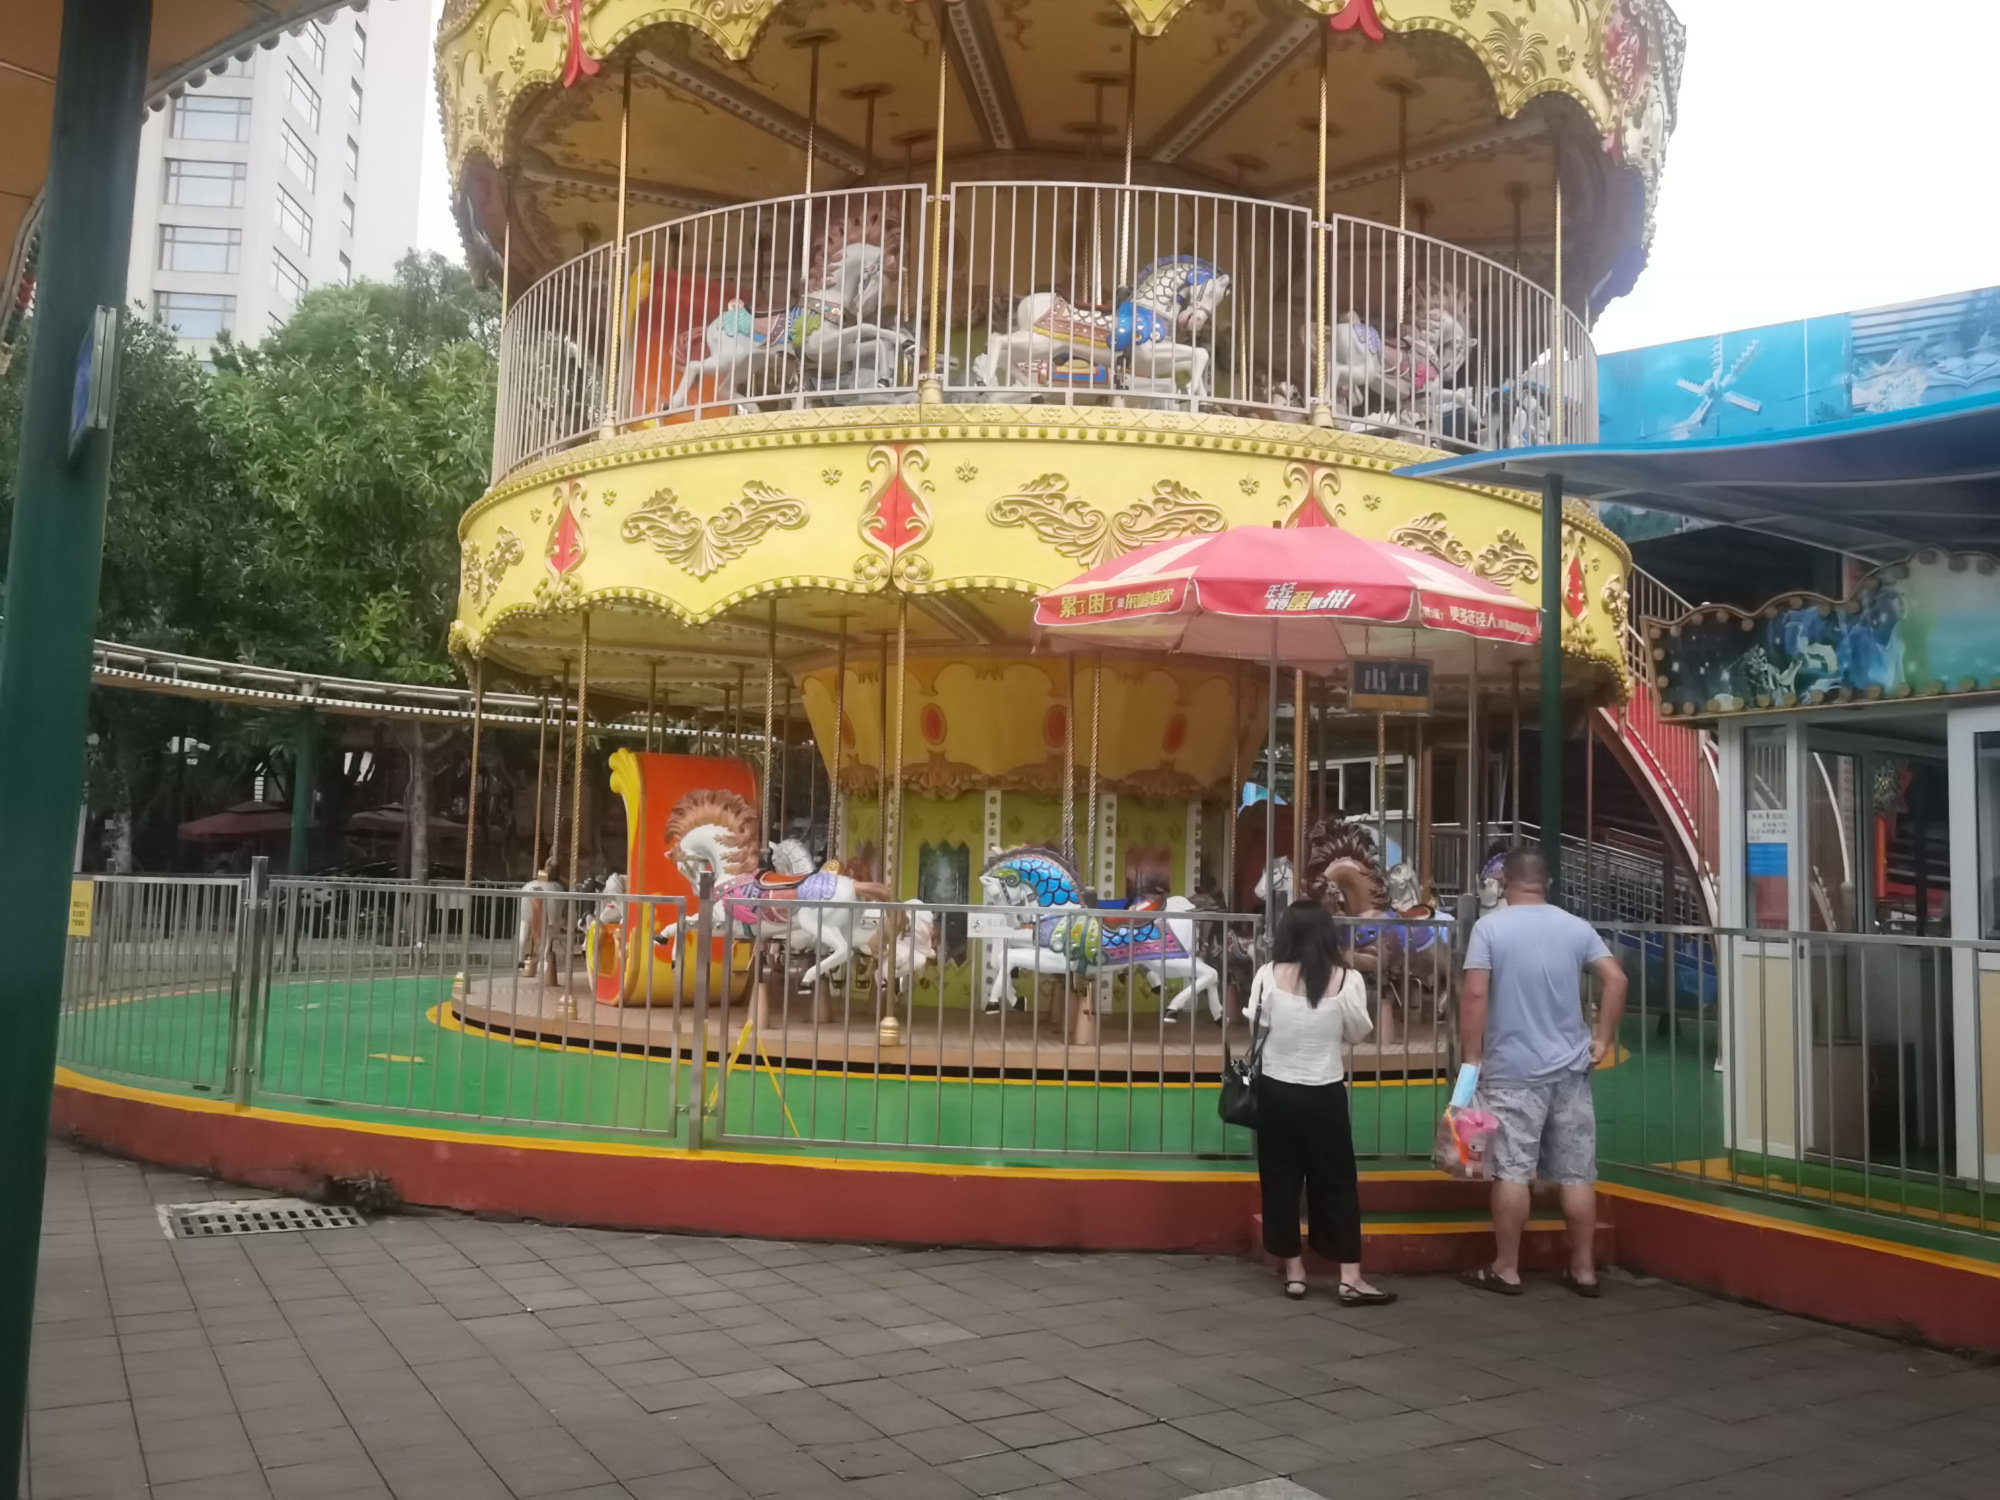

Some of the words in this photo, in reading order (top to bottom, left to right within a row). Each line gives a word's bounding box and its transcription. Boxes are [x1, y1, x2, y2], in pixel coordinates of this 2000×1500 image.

[1264, 581, 1298, 599] 年轻
[1059, 588, 1175, 618] 累了困了东鹏特饮
[1364, 668, 1419, 692] 出口
